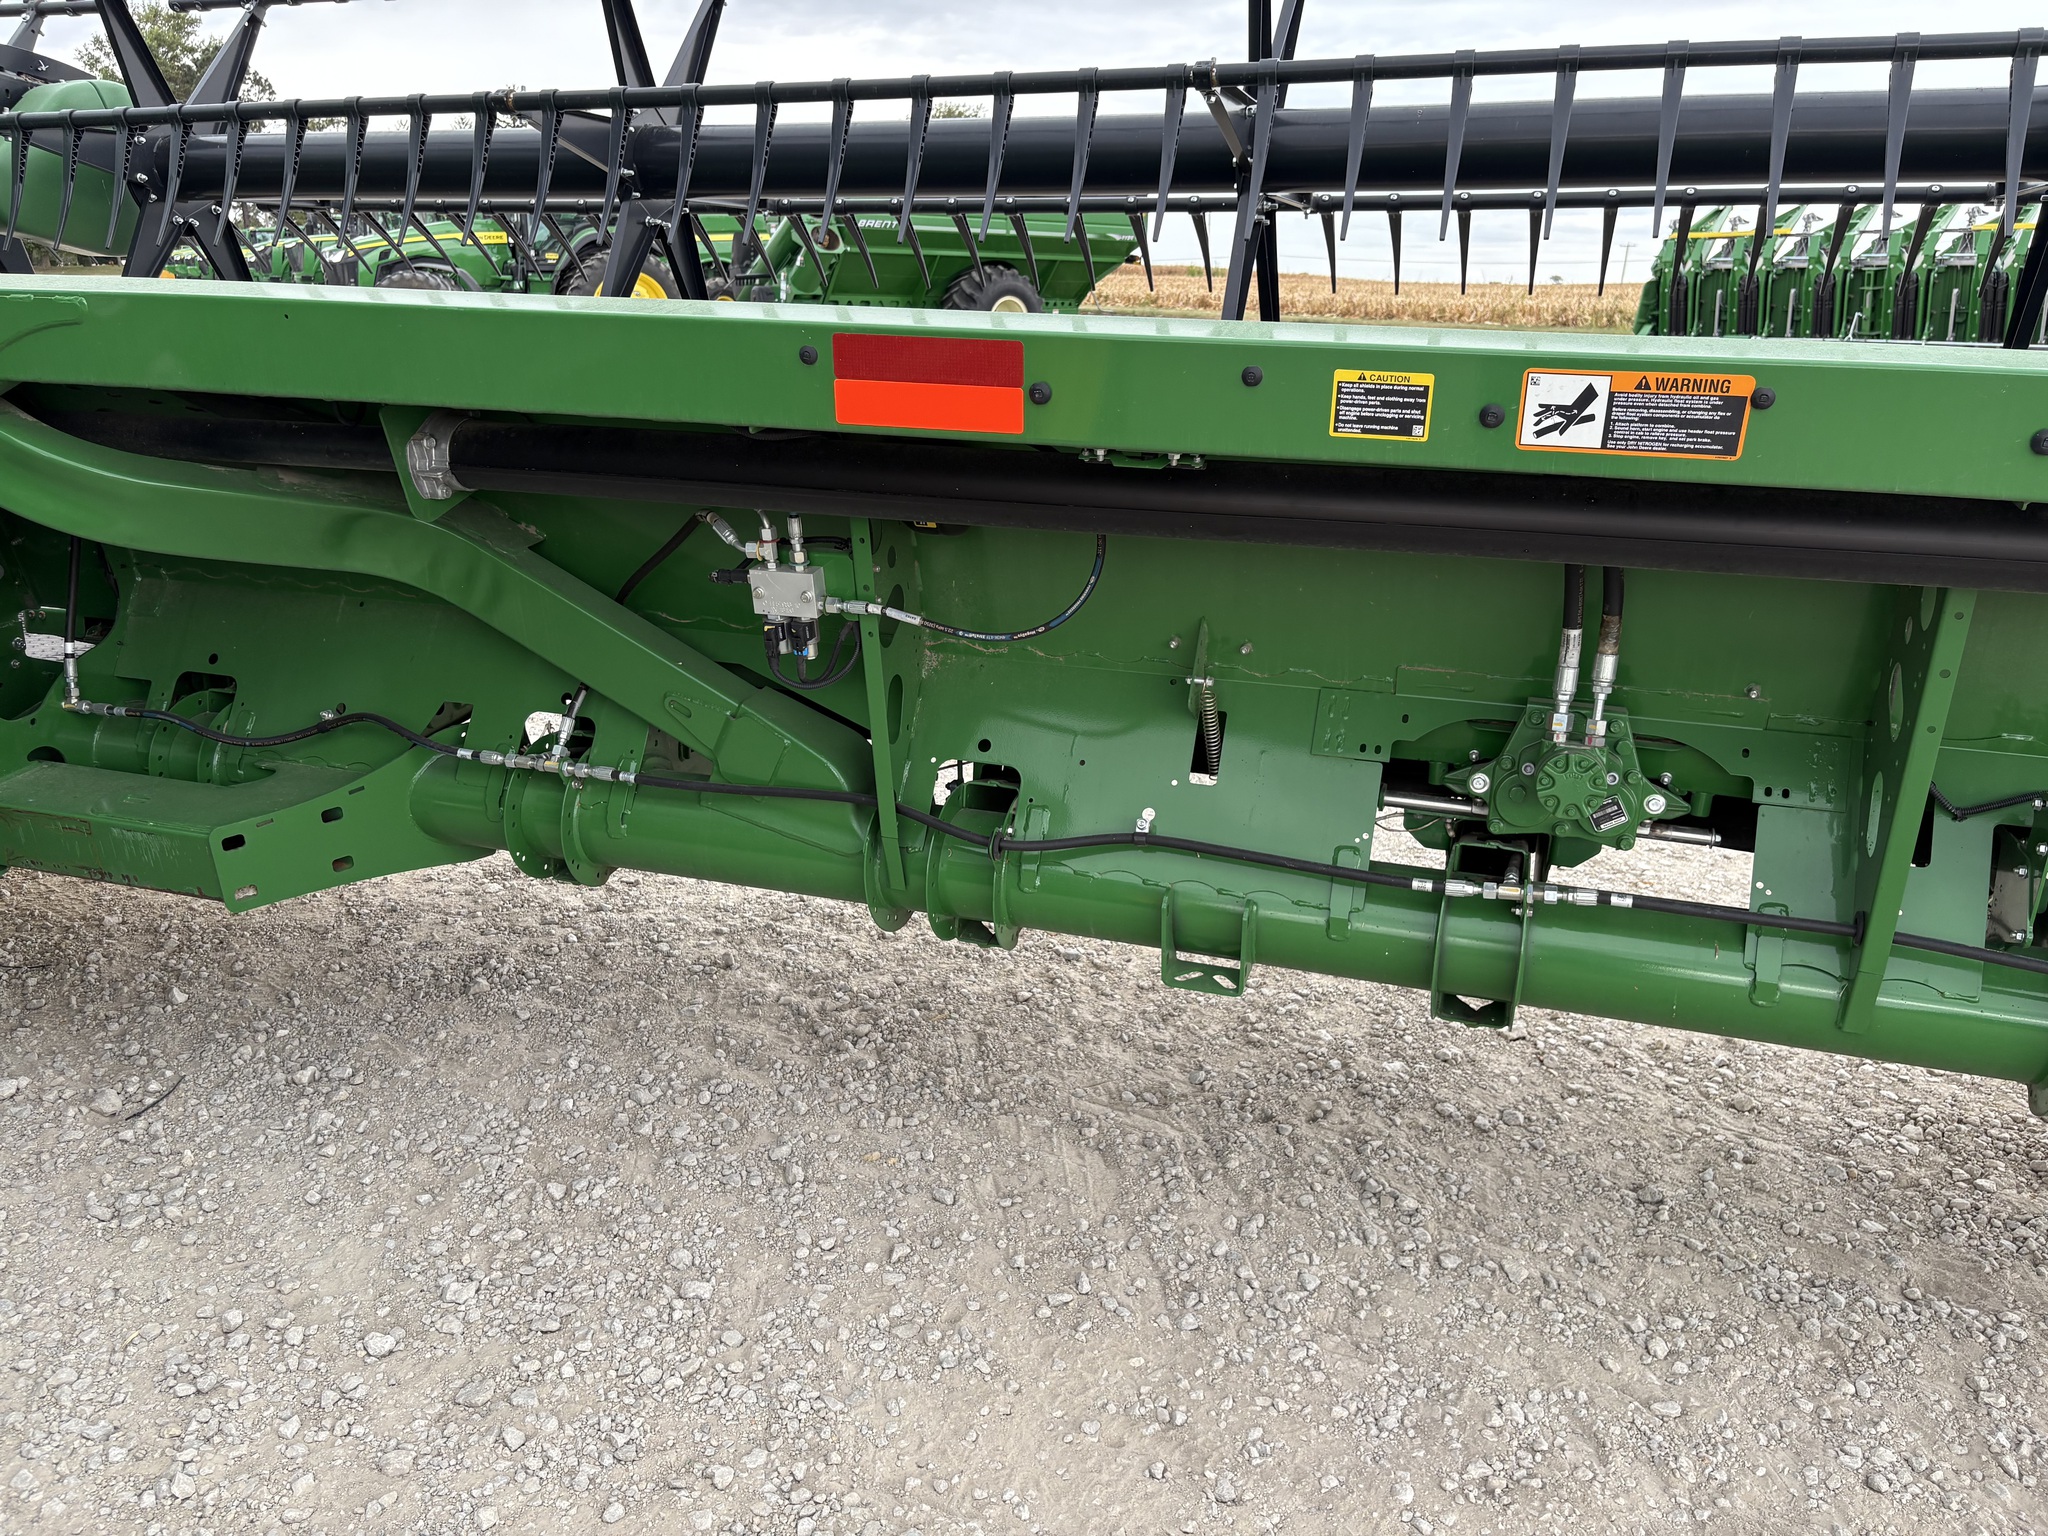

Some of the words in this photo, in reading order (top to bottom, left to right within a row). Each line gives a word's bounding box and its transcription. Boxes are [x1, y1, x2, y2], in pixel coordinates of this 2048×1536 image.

[858, 220, 898, 228] BRENT
[1370, 374, 1410, 383] CAUTION
[1655, 377, 1731, 394] WARNING
